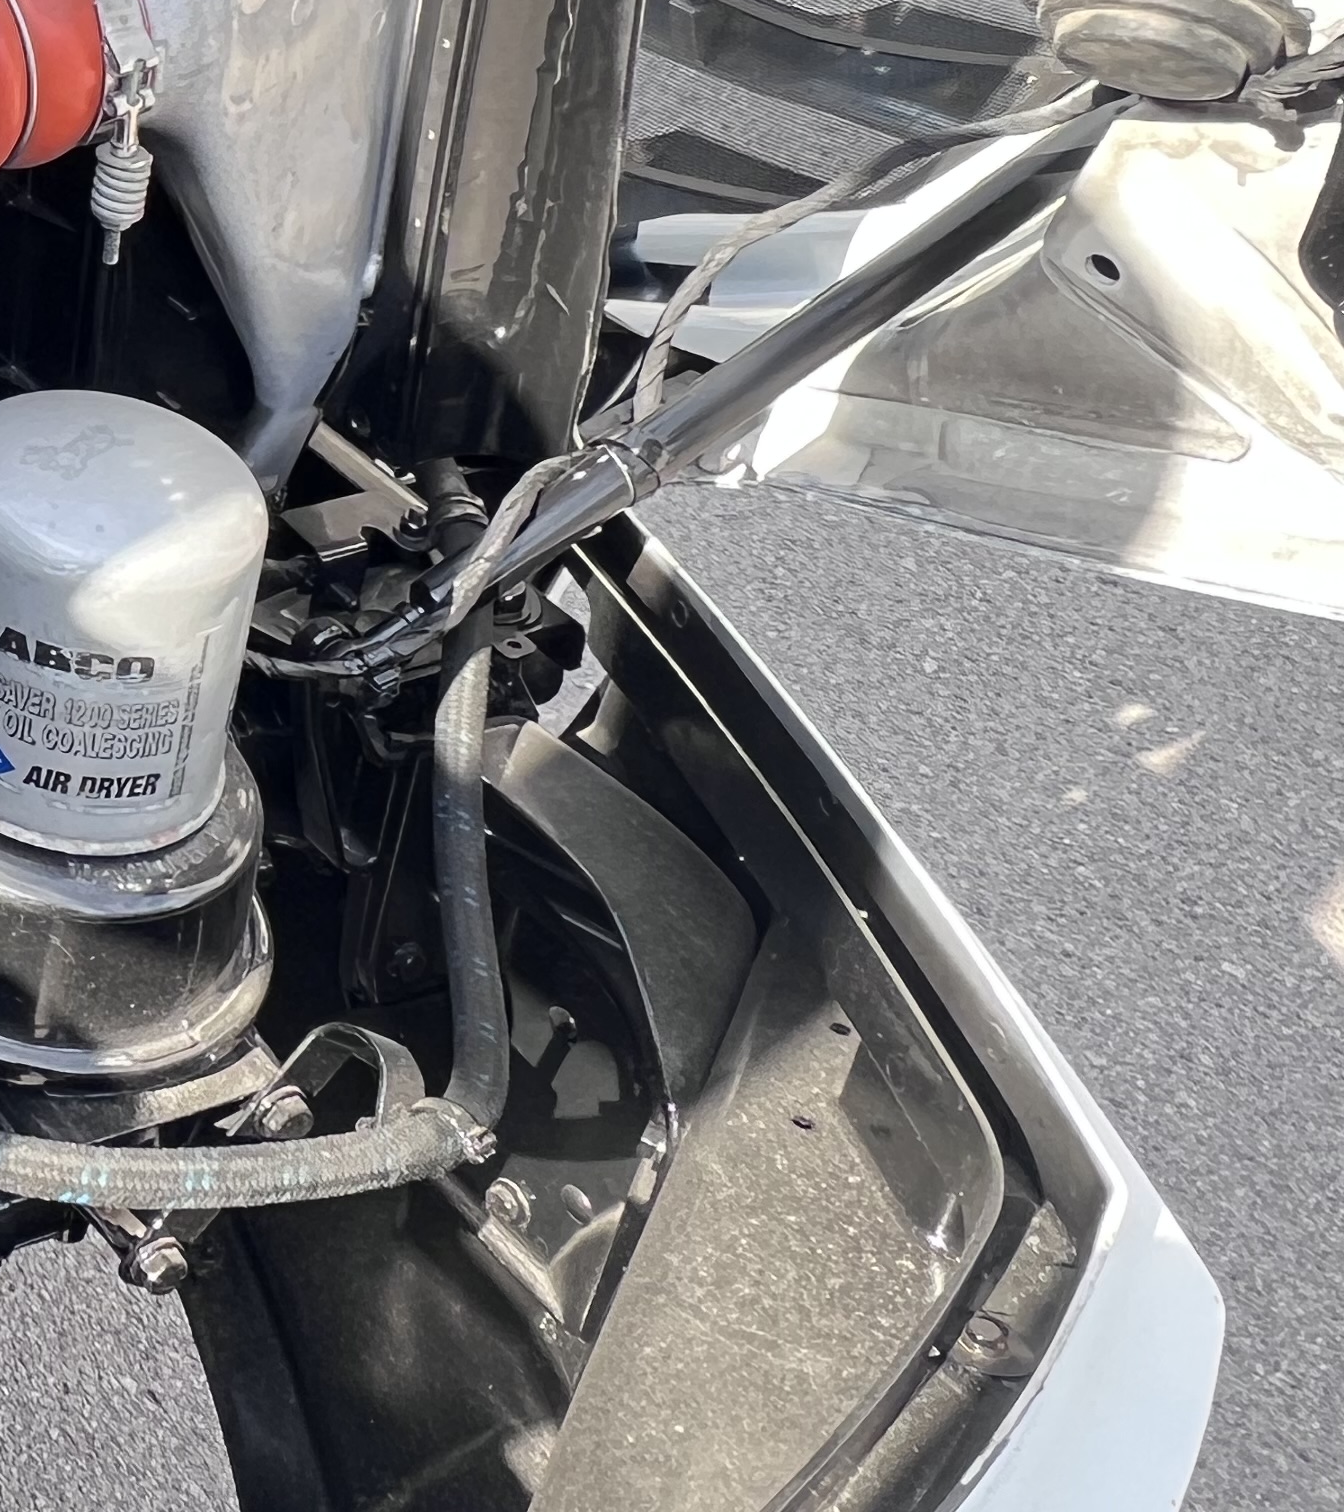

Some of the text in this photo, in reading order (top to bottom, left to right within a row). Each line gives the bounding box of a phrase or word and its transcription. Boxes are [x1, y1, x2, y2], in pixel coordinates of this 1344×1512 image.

[64, 698, 114, 729] 1200
[117, 699, 180, 731] SERIES
[3, 709, 36, 746] OIL
[41, 723, 174, 760] COALESCING
[22, 765, 161, 799] AIR DRYER
